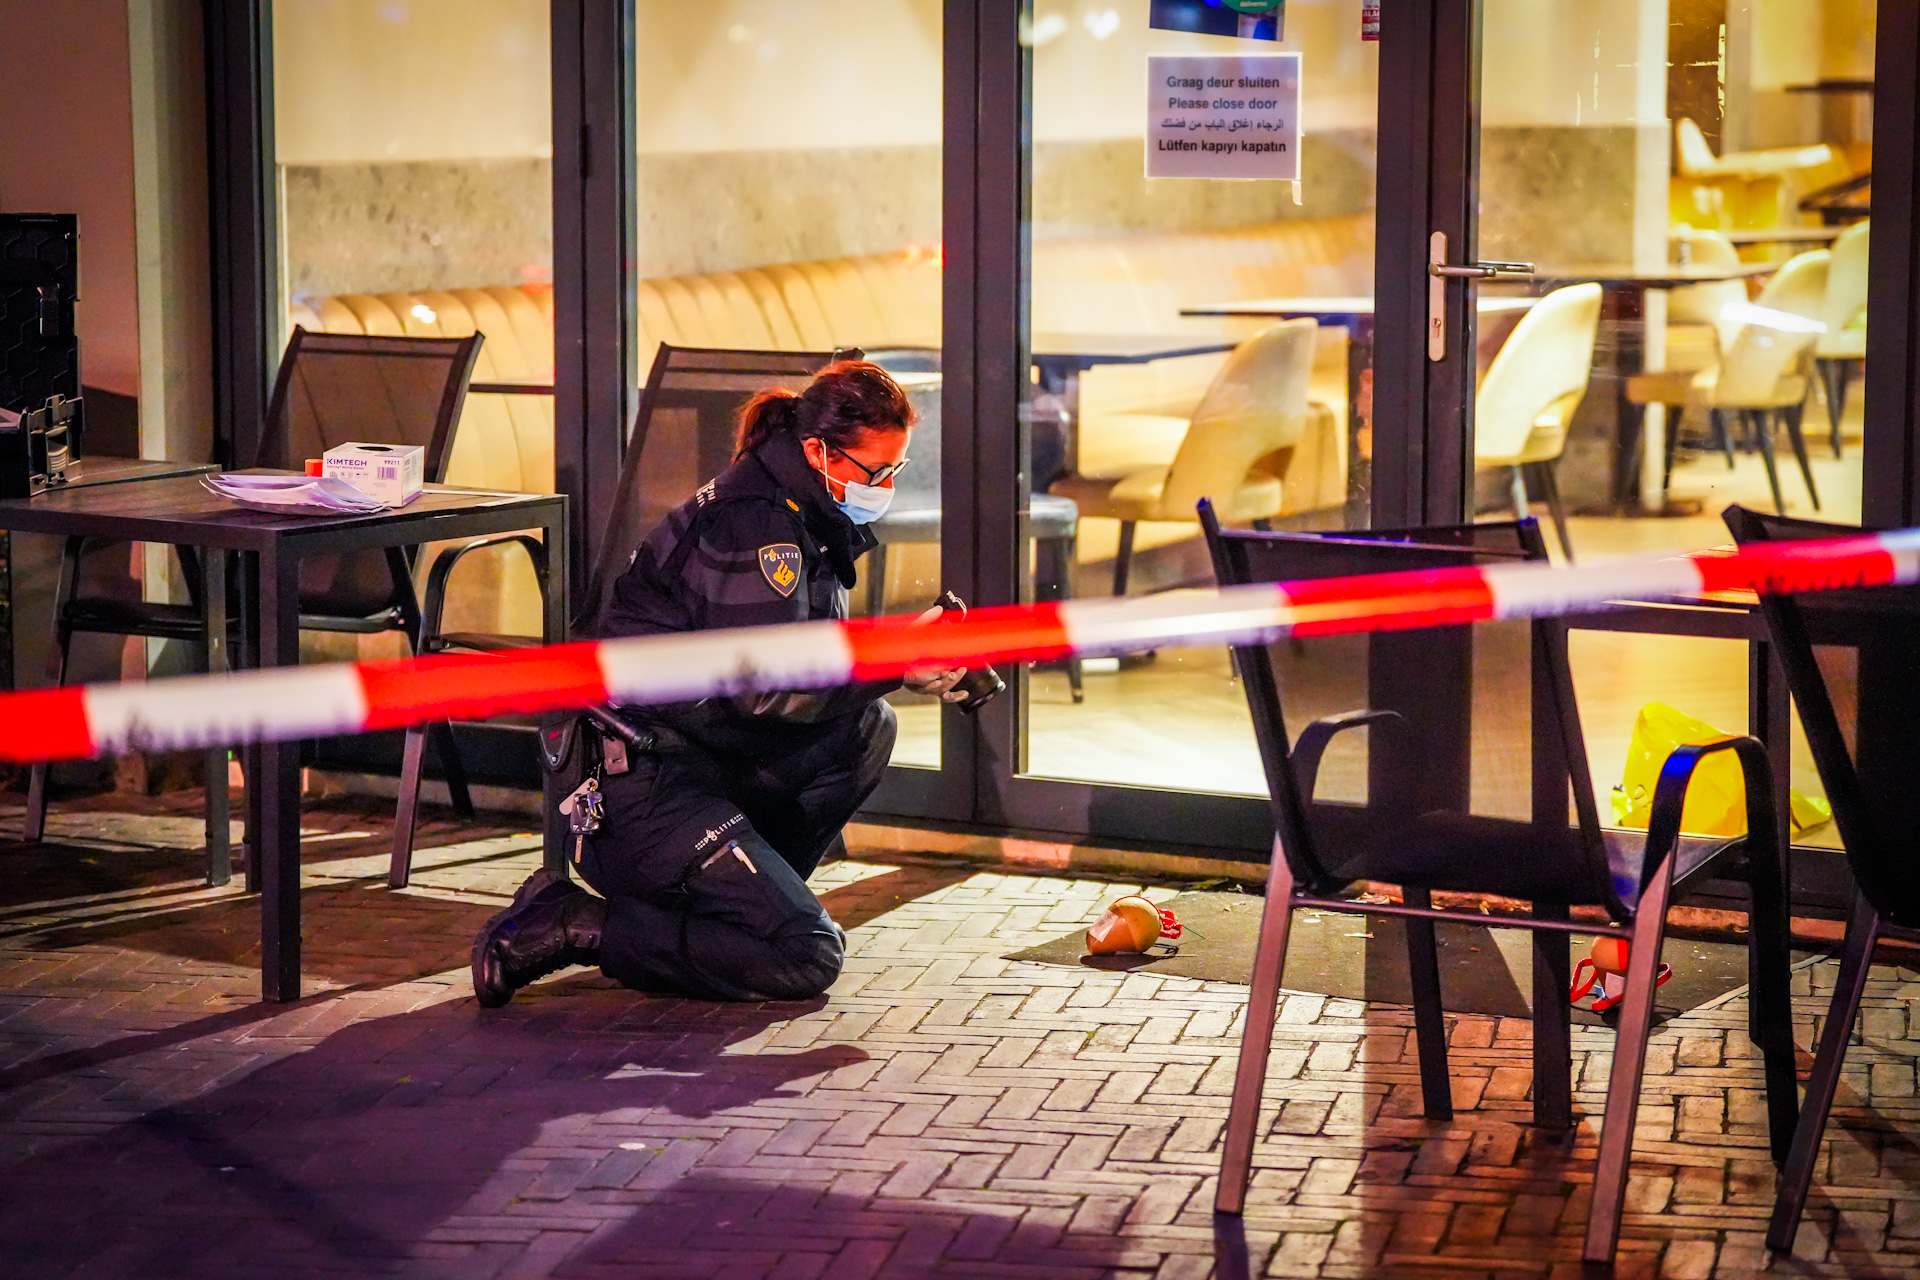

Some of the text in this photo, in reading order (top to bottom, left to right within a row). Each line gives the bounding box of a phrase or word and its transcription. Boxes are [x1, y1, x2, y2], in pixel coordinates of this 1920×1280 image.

[1166, 75, 1280, 91] Graag deur sluiten
[1168, 97, 1278, 109] Please close door
[1188, 119, 1202, 131] من
[1205, 118, 1225, 131] الباب
[1256, 118, 1284, 132] الرجاء
[1158, 139, 1286, 154] Lütfen kapıyı kapatın
[763, 552, 799, 561] POLITIE
[703, 819, 736, 844] POLITIE
